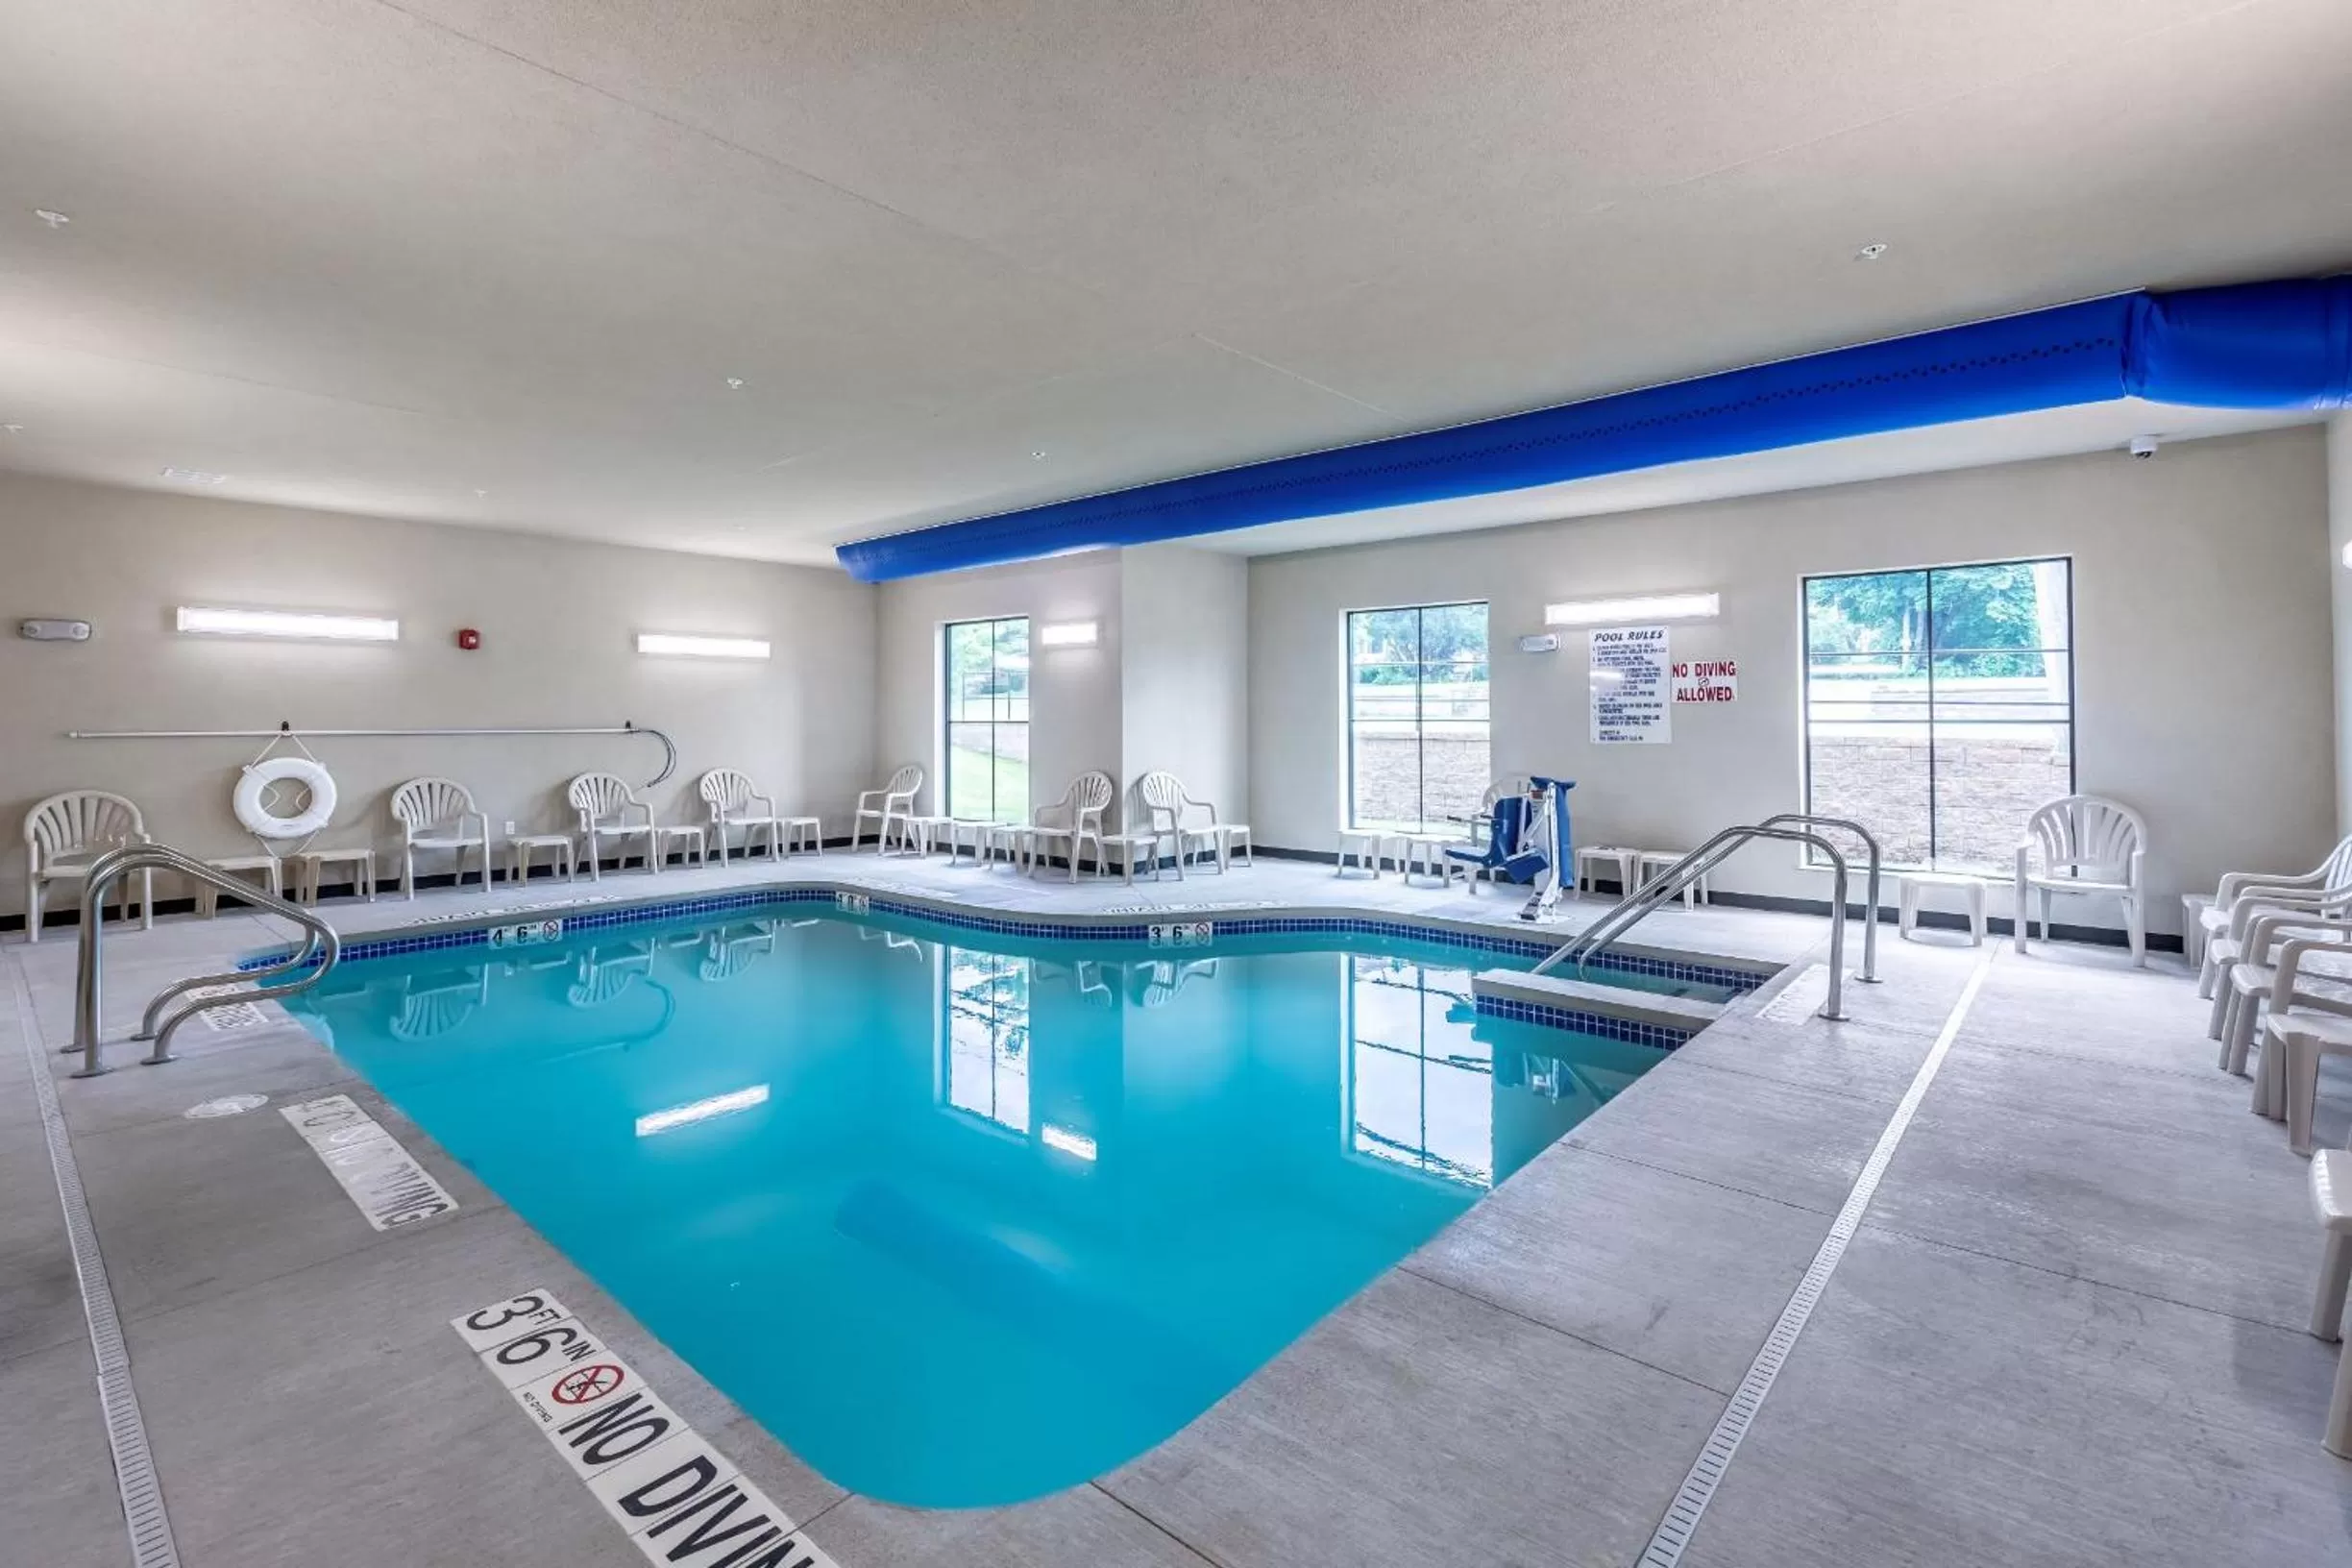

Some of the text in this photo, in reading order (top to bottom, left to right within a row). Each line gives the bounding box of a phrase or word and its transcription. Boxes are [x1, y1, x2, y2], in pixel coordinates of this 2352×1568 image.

[1594, 629, 1664, 642] POOL RULES
[1672, 661, 1736, 677] NO DIVING
[1677, 686, 1732, 701] ALLOWED
[1151, 926, 1162, 938] 3
[1173, 925, 1183, 938] 6
[467, 1296, 545, 1331] 3
[527, 1308, 561, 1325] FT
[497, 1328, 577, 1364] 6
[561, 1340, 597, 1361] IN
[558, 1393, 670, 1465] NO
